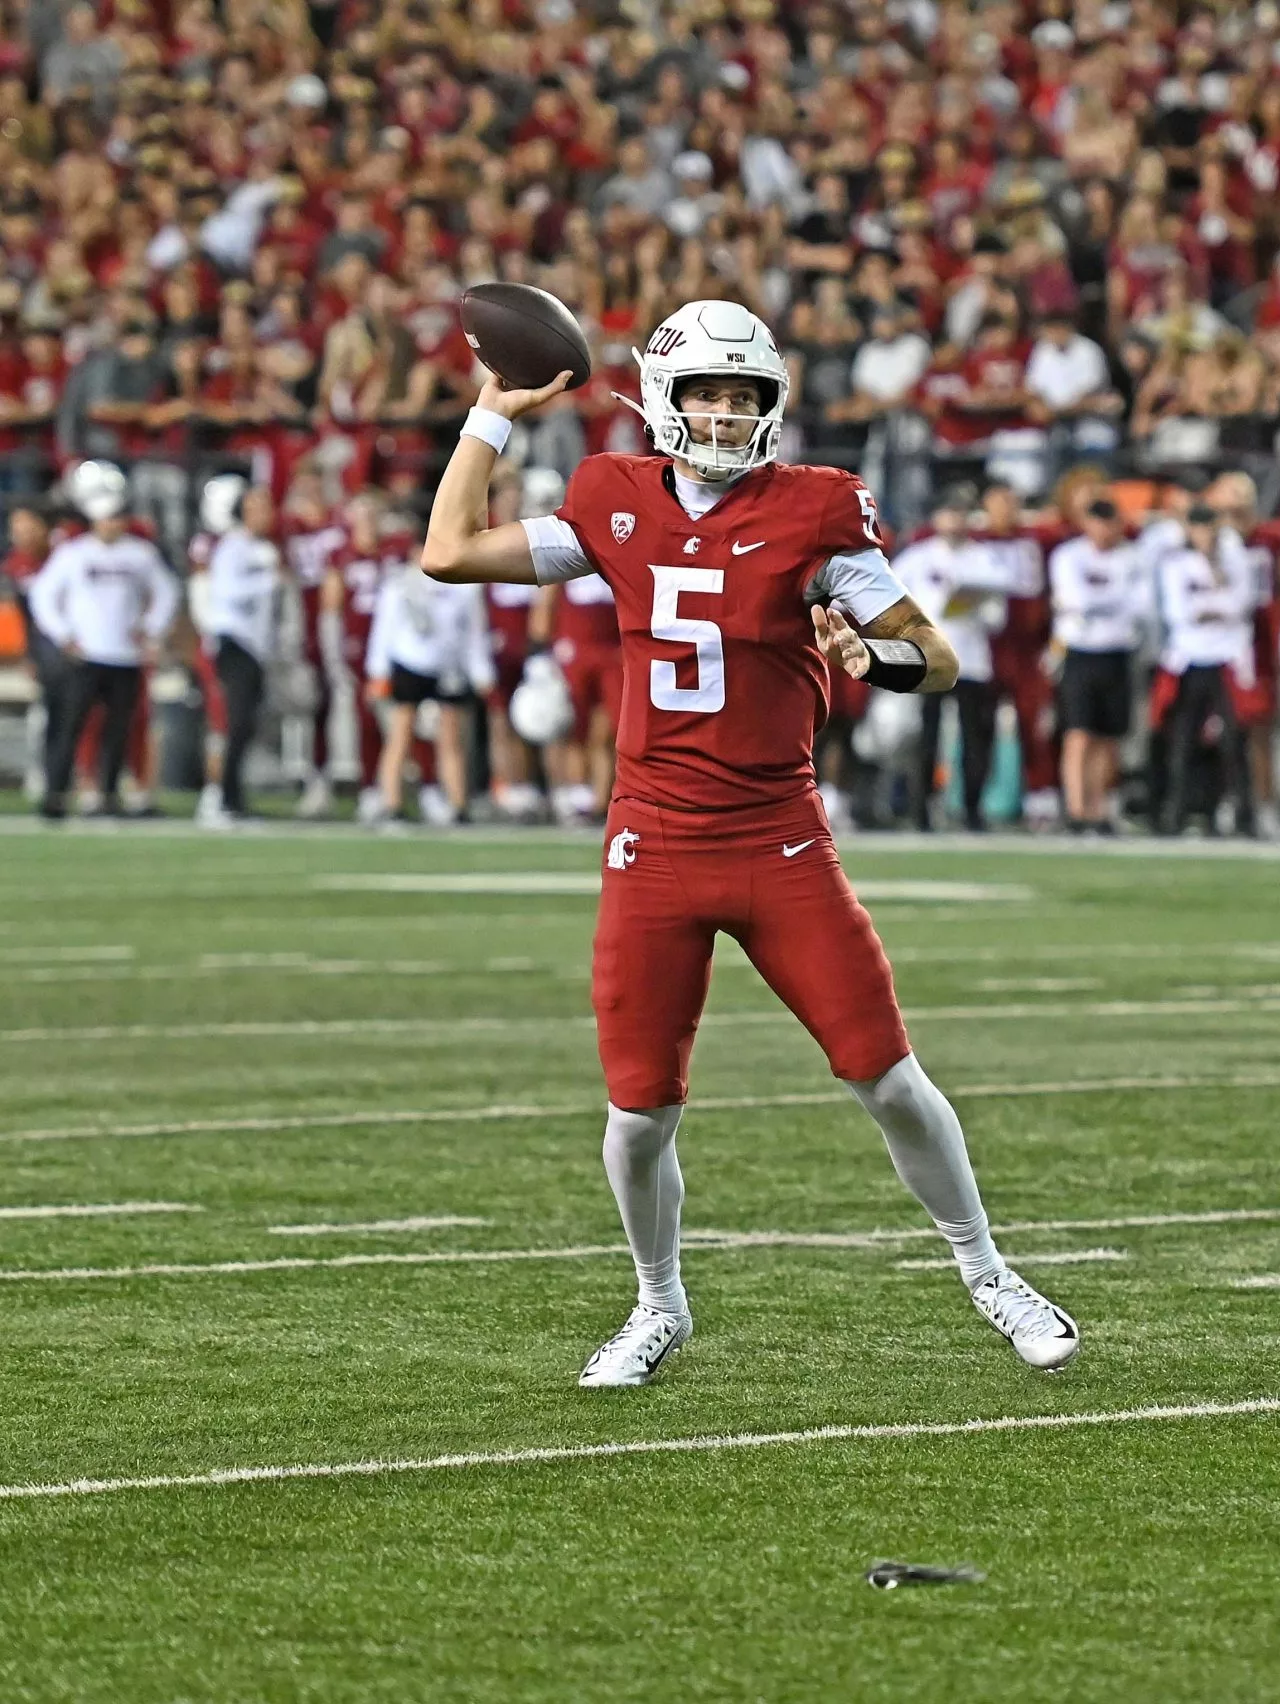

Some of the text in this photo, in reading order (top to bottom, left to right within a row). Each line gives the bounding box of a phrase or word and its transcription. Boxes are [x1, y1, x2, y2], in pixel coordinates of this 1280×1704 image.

[726, 352, 746, 363] WSU
[854, 489, 877, 541] 5
[615, 526, 629, 538] 12
[647, 564, 726, 713] 5
